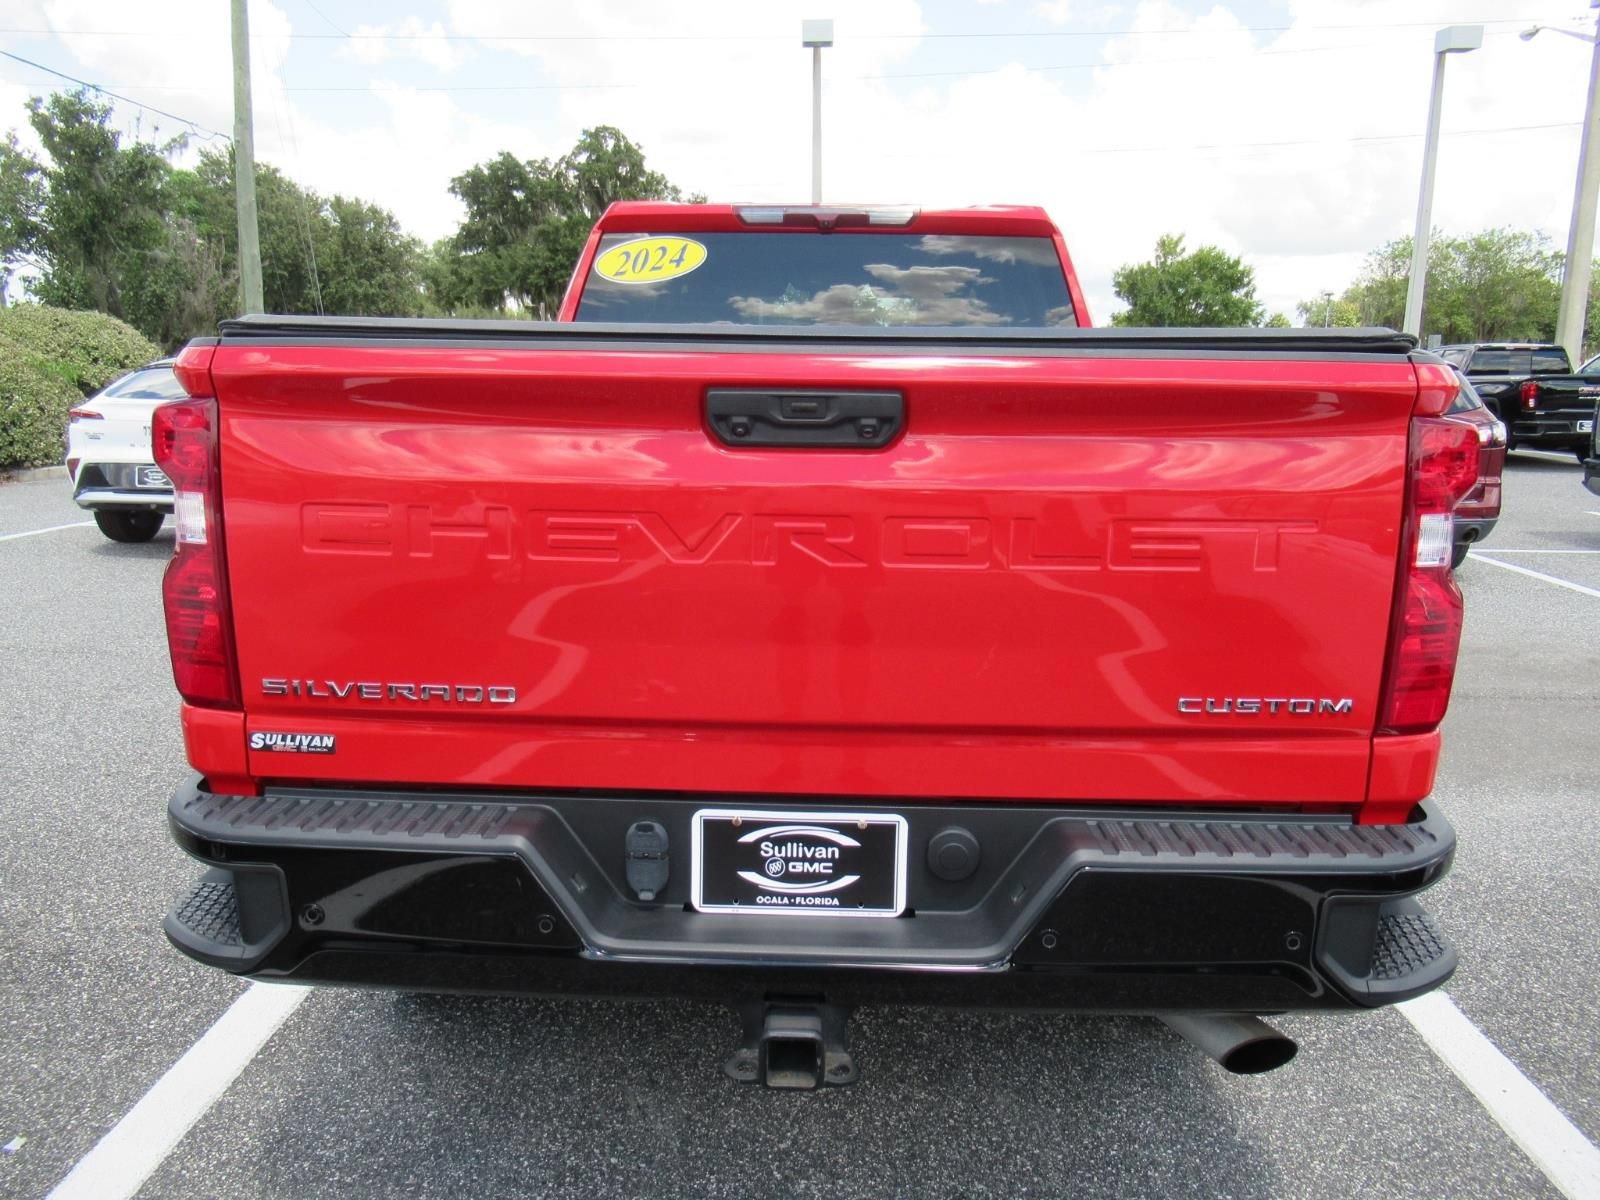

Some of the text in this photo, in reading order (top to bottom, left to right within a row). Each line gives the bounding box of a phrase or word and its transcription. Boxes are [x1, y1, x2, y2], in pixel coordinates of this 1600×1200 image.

[613, 243, 688, 277] 2024
[301, 501, 1319, 573] CHEVROLET
[261, 677, 517, 704] SILVERADO
[1177, 697, 1353, 714] CUSTOM
[250, 732, 335, 749] SULLIVAN
[760, 841, 839, 859] Sullivan
[788, 861, 833, 873] GMC
[756, 895, 840, 906] OCALA FLORIDA
